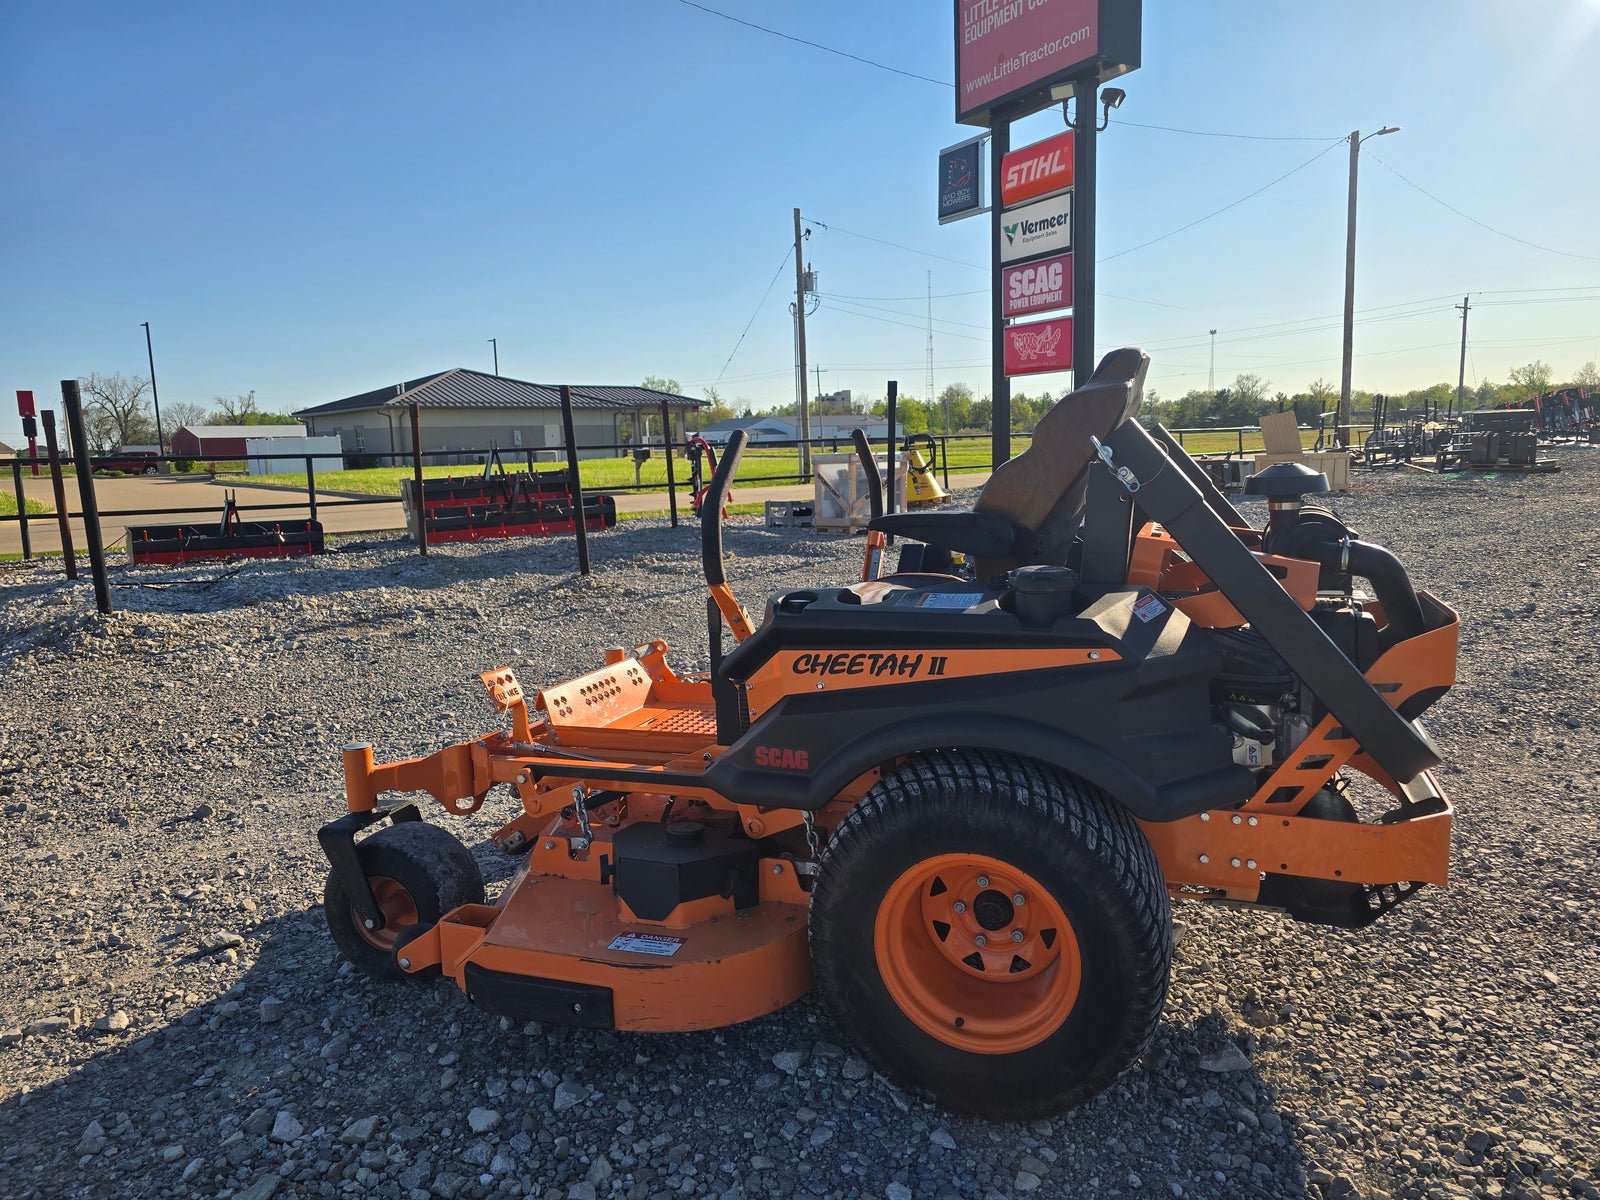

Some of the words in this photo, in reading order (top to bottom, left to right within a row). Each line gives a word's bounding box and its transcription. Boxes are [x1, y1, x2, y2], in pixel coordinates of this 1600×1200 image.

[964, 0, 1023, 45] EQUIPMENT
[966, 26, 1090, 93] www.LittleTractor.com
[1005, 149, 1066, 190] STIHL
[957, 187, 971, 197] BOY
[1020, 212, 1068, 236] Vermeer
[1023, 233, 1044, 243] Equipment
[1009, 262, 1063, 299] SCAG
[1009, 297, 1029, 310] POWER
[1030, 290, 1063, 306] EQUIPMENT
[792, 653, 923, 678] CHEETAH
[928, 656, 948, 676] II
[755, 746, 809, 770] SCAG
[640, 934, 680, 943] DANGER
